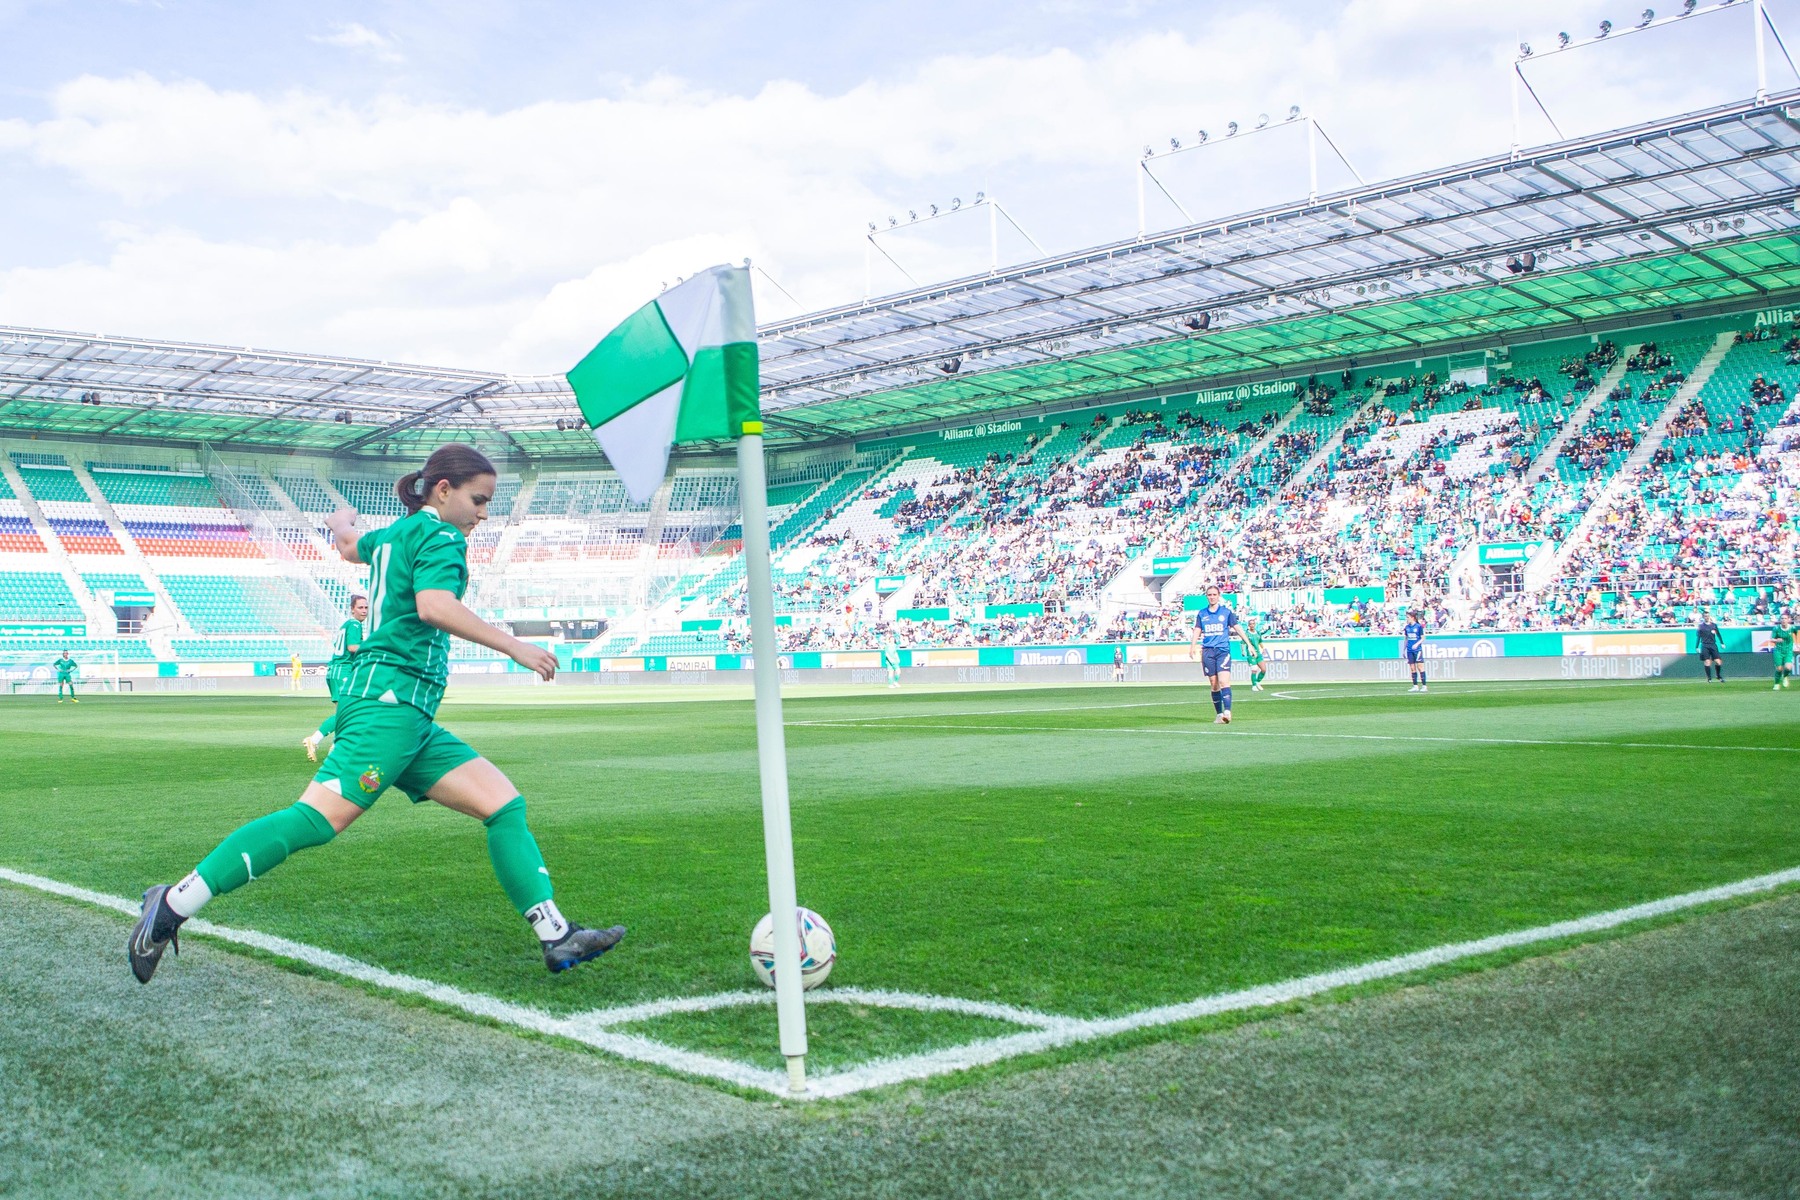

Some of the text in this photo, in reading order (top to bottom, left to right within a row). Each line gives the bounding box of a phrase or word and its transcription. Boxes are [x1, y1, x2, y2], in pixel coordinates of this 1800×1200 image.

[1196, 381, 1296, 404] Allianz Stadion
[944, 421, 1022, 440] Allianz Stadion
[1263, 647, 1337, 661] ADMIRAL
[1421, 644, 1469, 658] llianz
[669, 660, 710, 670] ADMIRAL
[1020, 653, 1063, 665] Allianz
[1561, 657, 1661, 676] SK RAPID 1899
[958, 667, 967, 682] SK
[970, 667, 991, 682] RAPID
